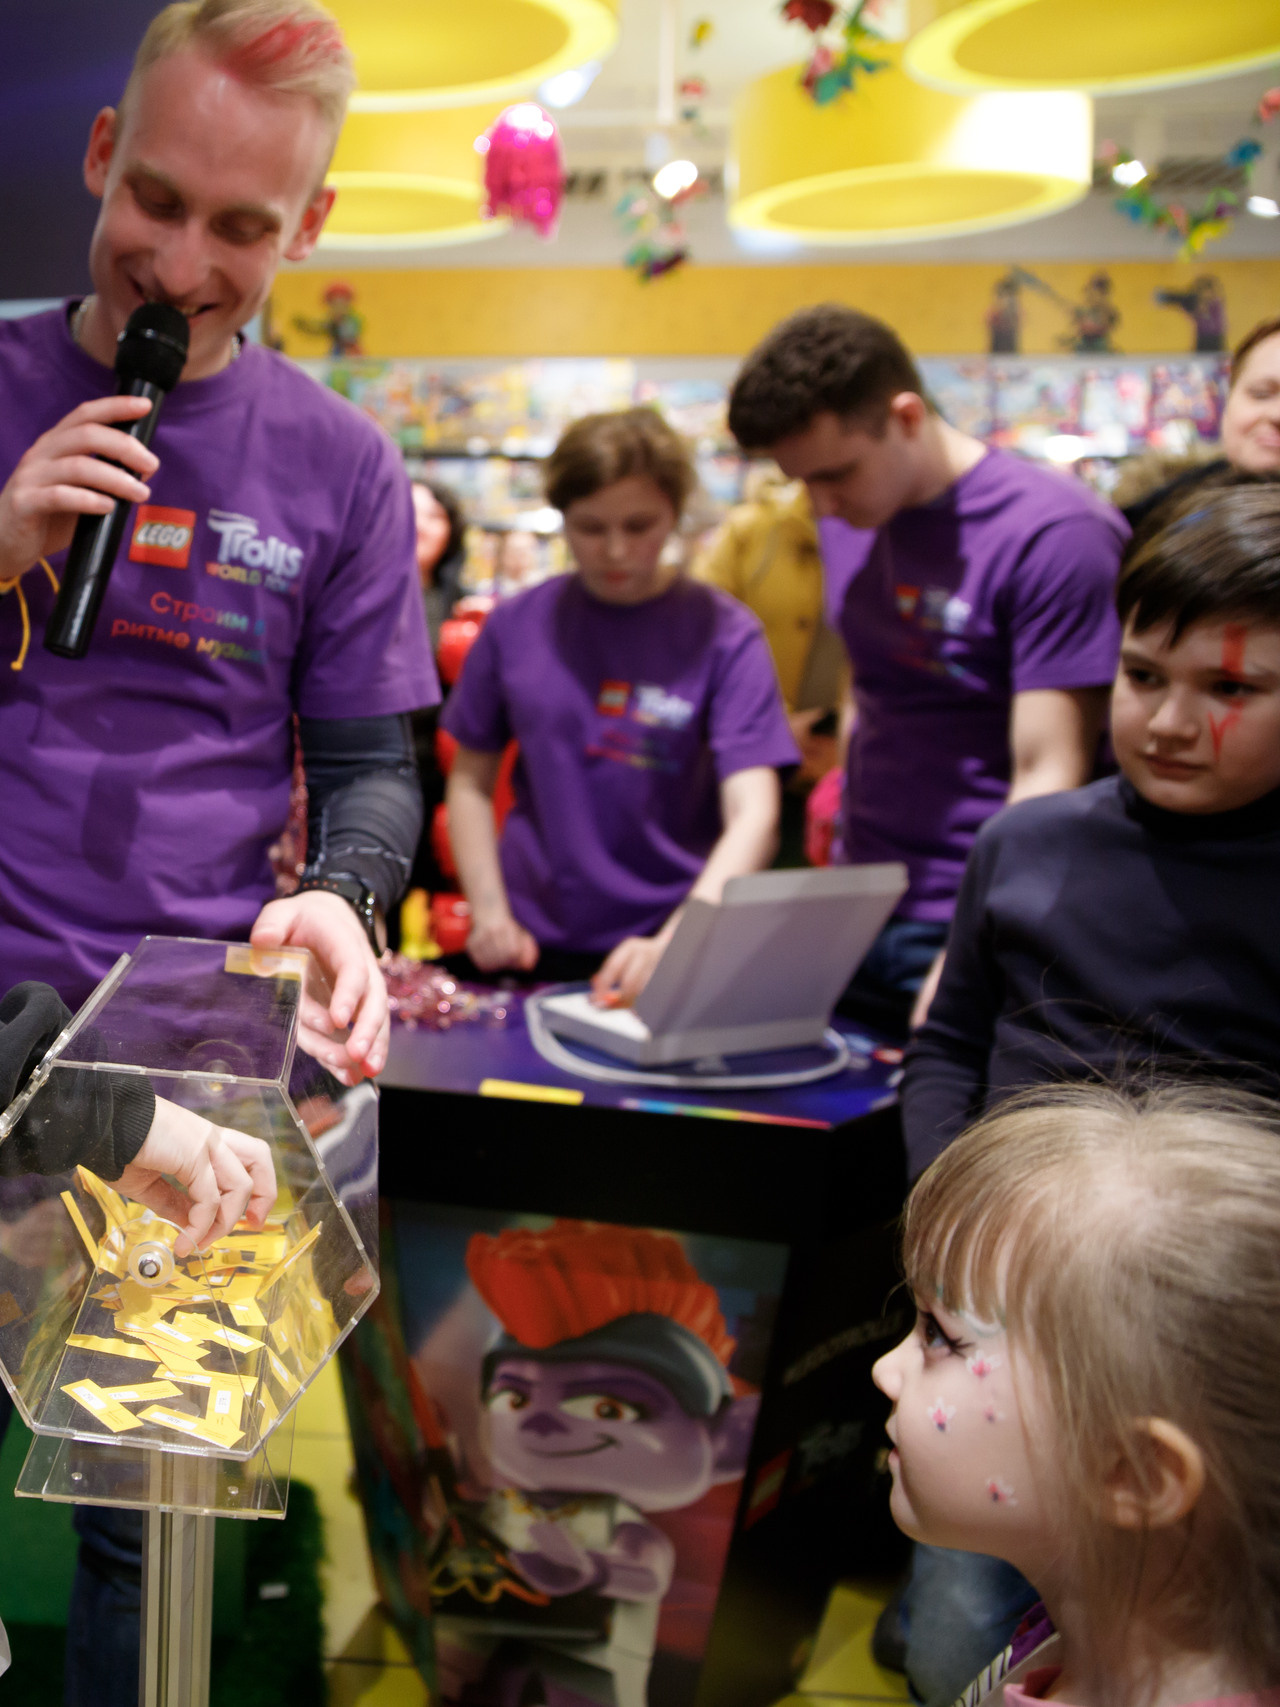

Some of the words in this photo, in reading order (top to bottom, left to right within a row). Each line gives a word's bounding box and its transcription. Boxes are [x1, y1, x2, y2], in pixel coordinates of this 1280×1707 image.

[135, 522, 191, 551] LEGO
[206, 514, 305, 580] Trolls
[149, 590, 250, 633] Строим
[110, 618, 191, 650] ритме
